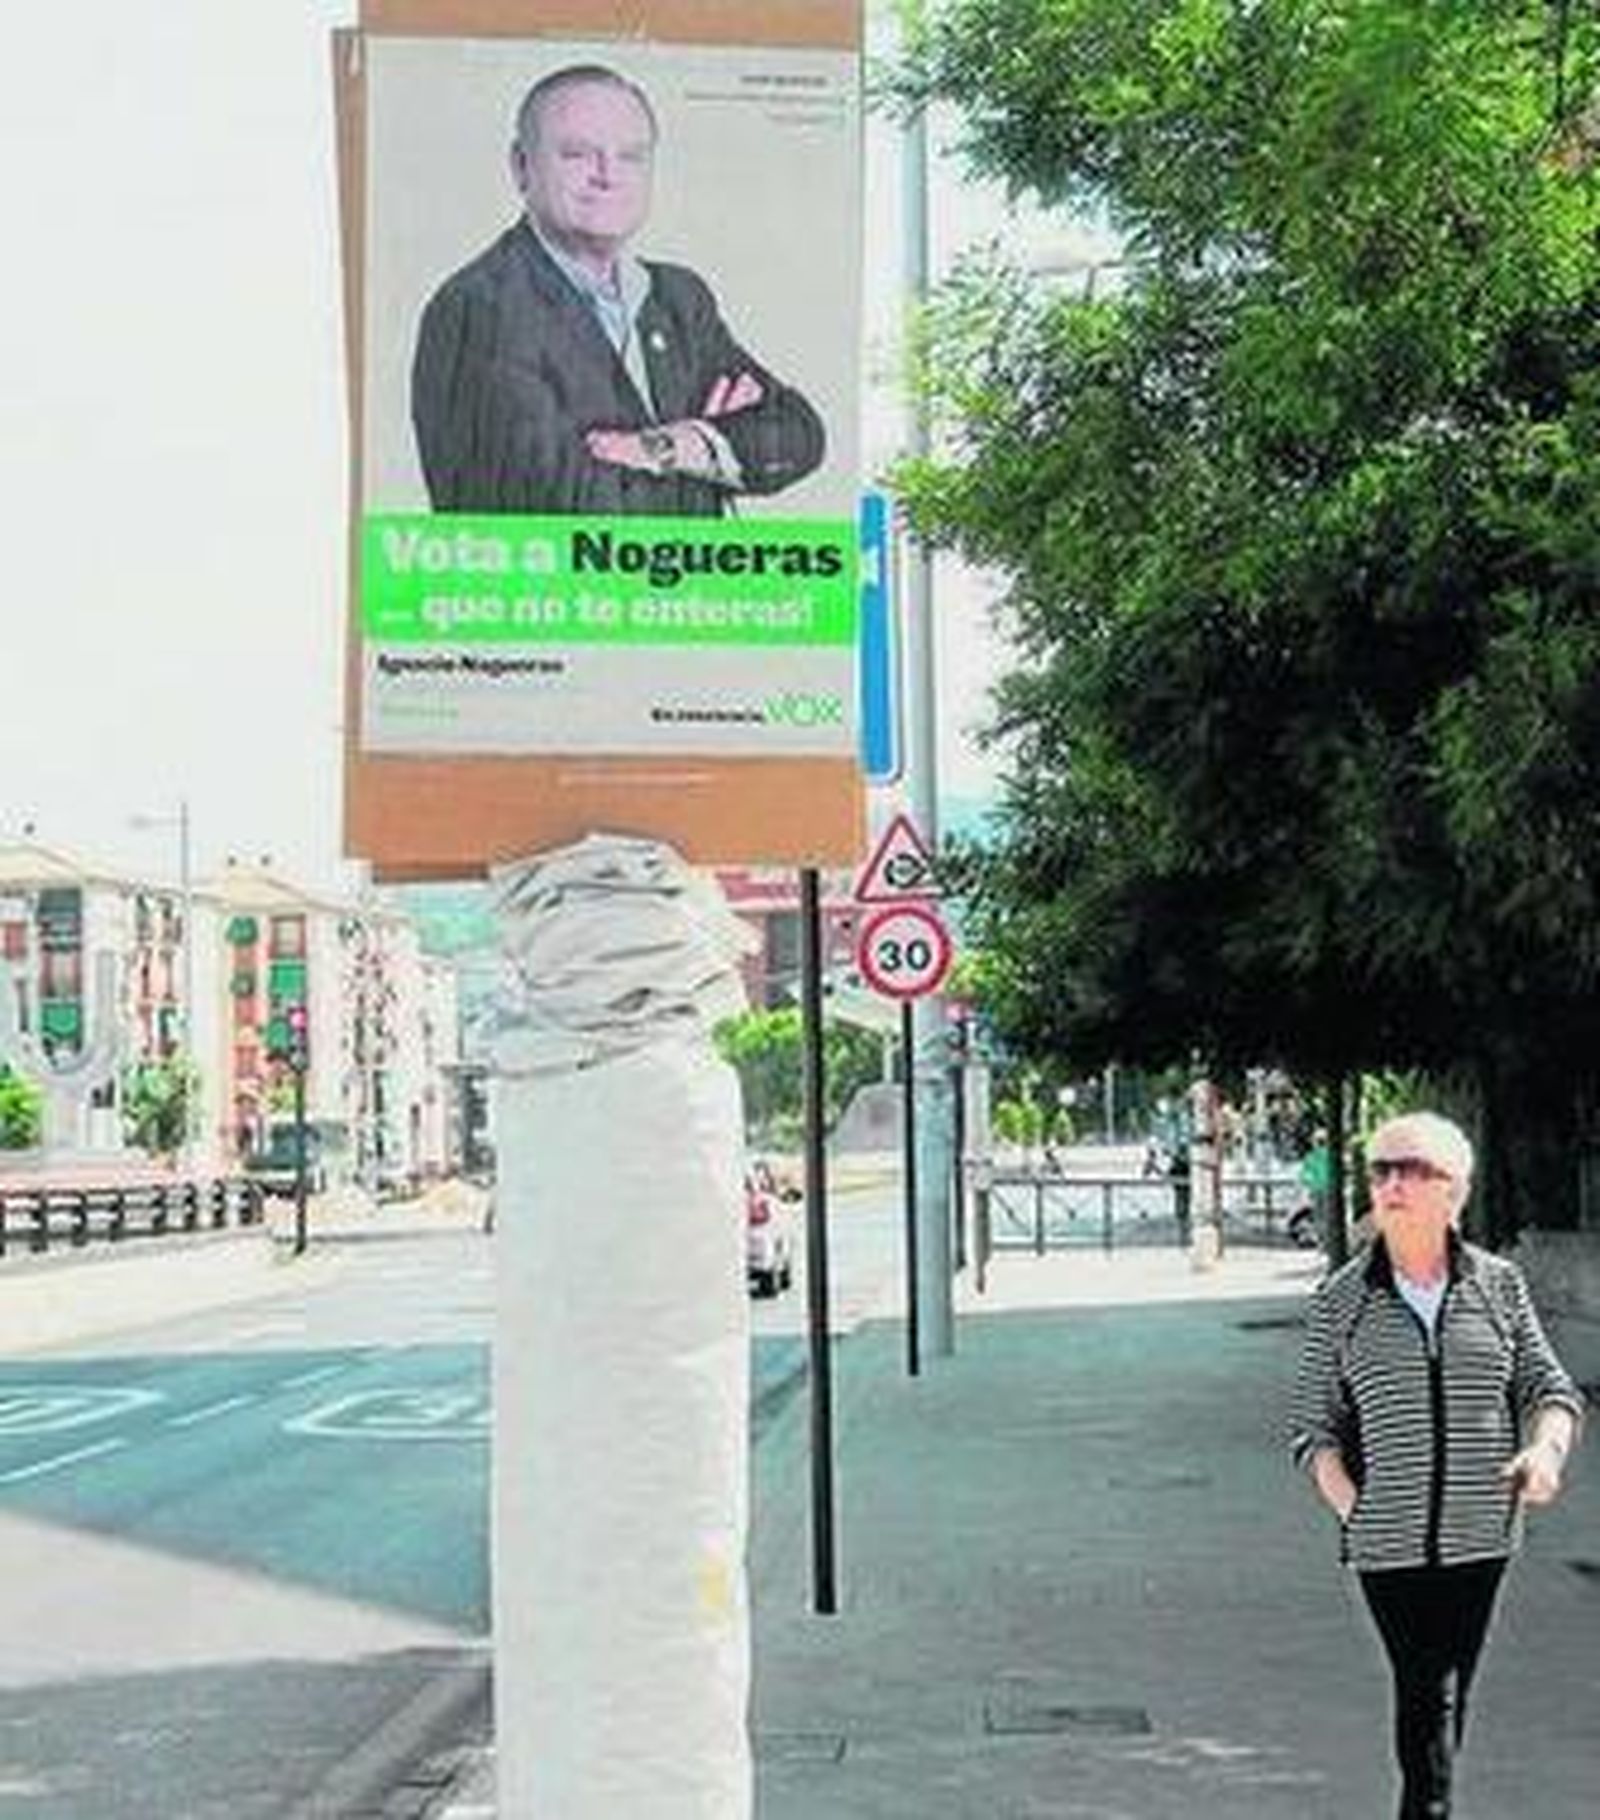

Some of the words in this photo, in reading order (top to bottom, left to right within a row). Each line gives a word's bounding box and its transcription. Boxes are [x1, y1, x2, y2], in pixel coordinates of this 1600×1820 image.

[381, 528, 507, 574] Vota
[521, 539, 555, 573] a
[571, 530, 843, 588] Nogueras
[421, 596, 506, 632] que
[514, 597, 566, 623] no
[579, 593, 618, 623] te
[461, 655, 564, 678] Nogueras
[763, 694, 843, 726] VOX
[876, 938, 932, 973] 30
